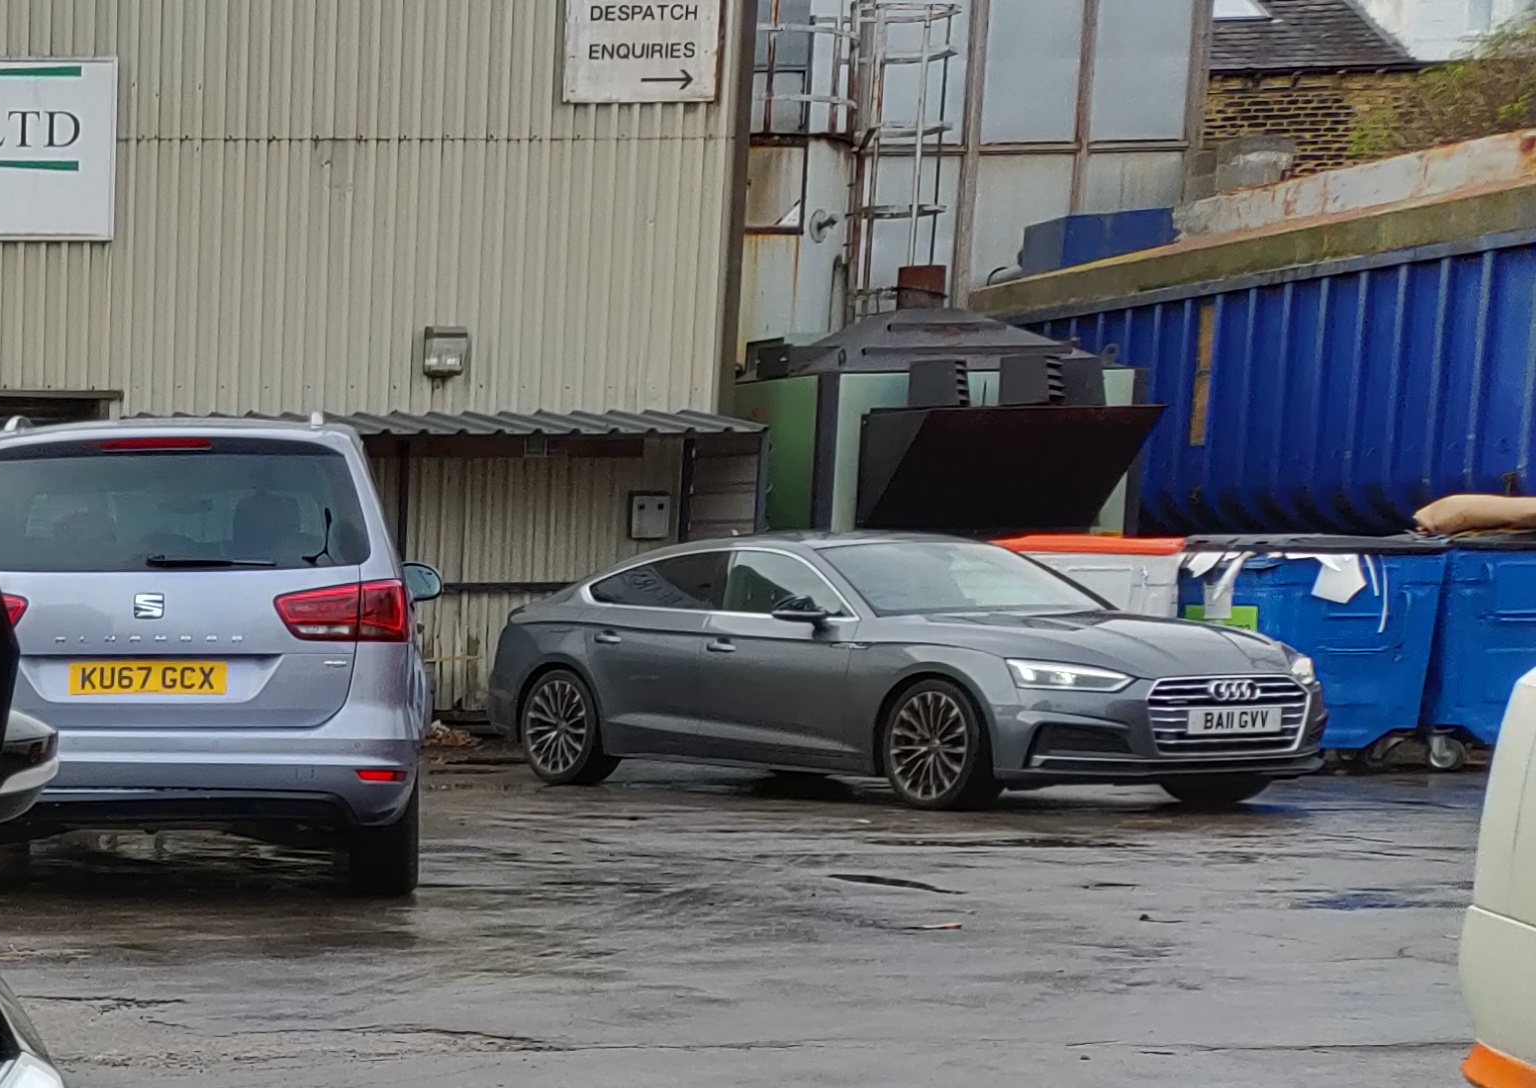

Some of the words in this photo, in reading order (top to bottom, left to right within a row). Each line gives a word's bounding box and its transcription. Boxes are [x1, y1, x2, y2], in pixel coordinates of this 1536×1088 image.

[590, 4, 698, 21] DESPATCH
[588, 42, 695, 60] ENQUIRIES
[80, 666, 152, 690] KU67
[162, 666, 215, 690] GCX
[1239, 710, 1269, 729] GVV
